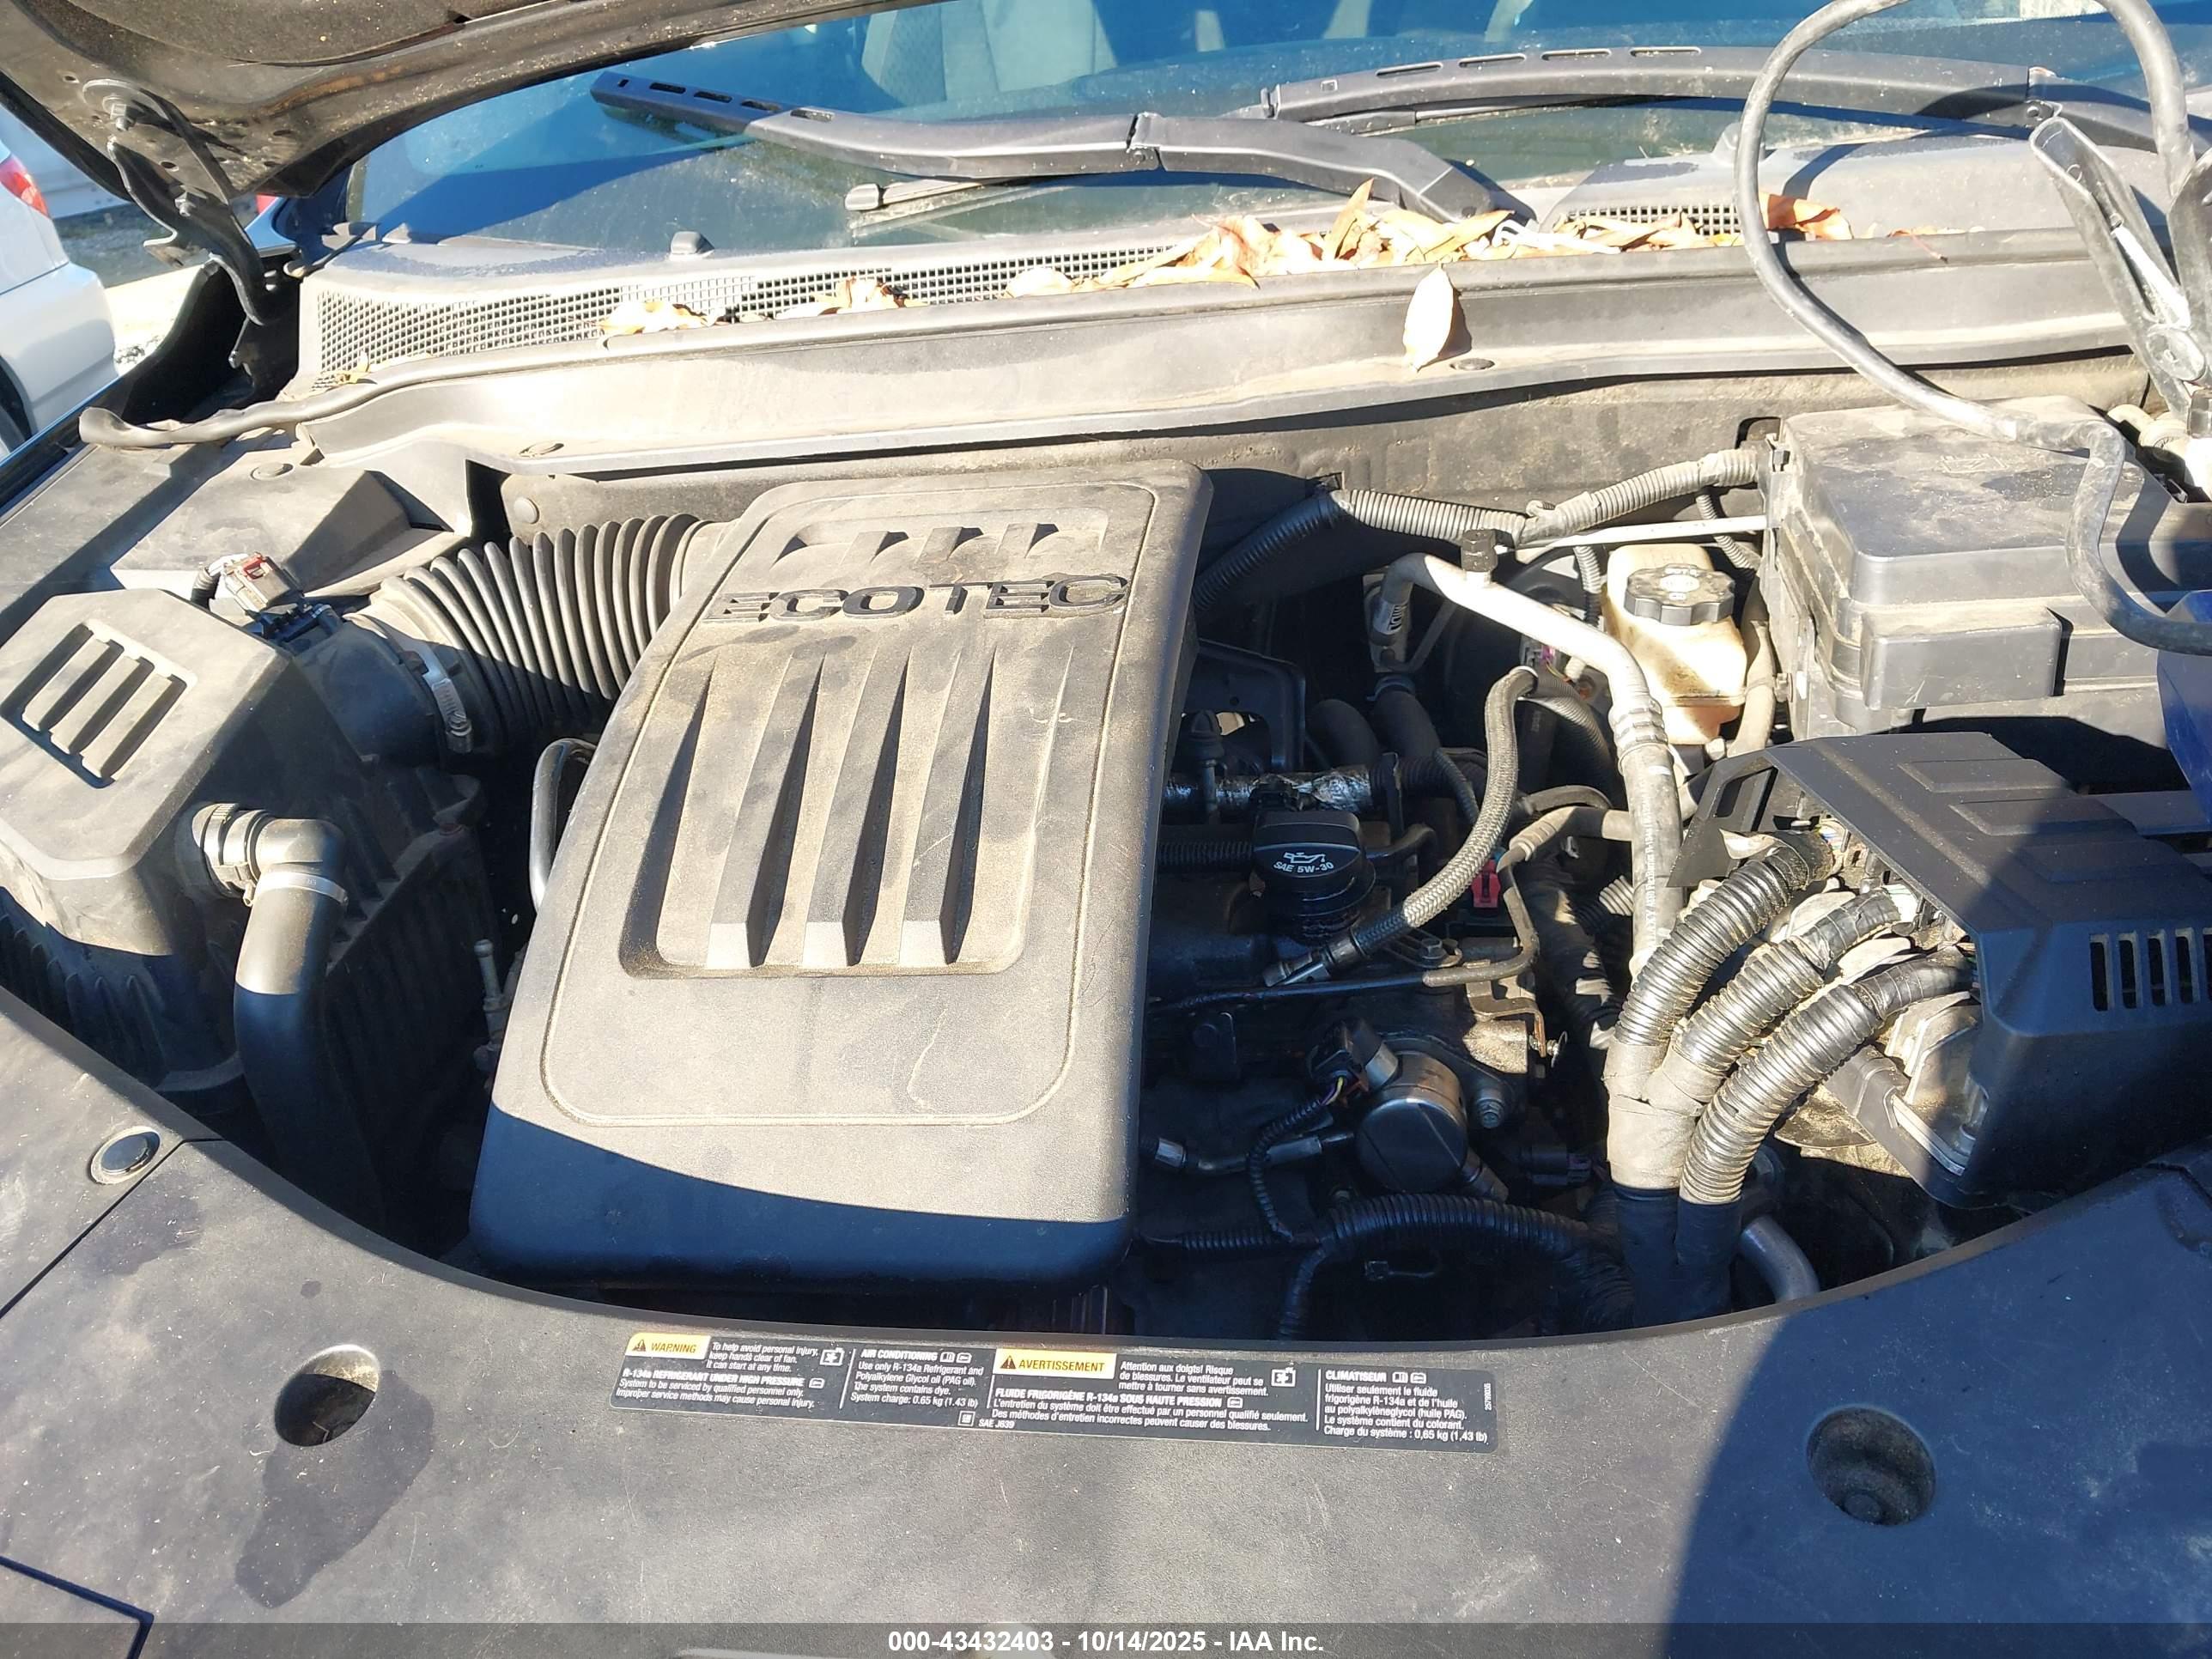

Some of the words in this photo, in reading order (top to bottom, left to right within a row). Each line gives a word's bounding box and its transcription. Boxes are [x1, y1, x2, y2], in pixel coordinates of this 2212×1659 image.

[703, 576, 1129, 623] ECOTEC
[1273, 860, 1293, 872] SAE
[1297, 861, 1334, 873] 5W-30
[650, 1342, 696, 1352] WARNING
[712, 1342, 722, 1351] To
[721, 1343, 739, 1352] help
[739, 1344, 760, 1352] avoid
[761, 1345, 794, 1355] personal
[708, 1352, 727, 1361] keep
[728, 1352, 752, 1361] hands
[753, 1353, 773, 1362] clear
[860, 1349, 877, 1358] AIR
[877, 1350, 938, 1360] CONDITIONING
[772, 1364, 793, 1372] time.
[858, 1361, 873, 1370] Use
[873, 1362, 891, 1372] only
[892, 1363, 921, 1371] R-134a
[922, 1364, 967, 1376] Refrigerant
[968, 1366, 983, 1375] and
[1018, 1358, 1104, 1372] AVERTISSEMENT
[1121, 1362, 1157, 1371] Attention
[1175, 1364, 1203, 1375] doigts!
[1205, 1365, 1233, 1376] Risque
[622, 1369, 652, 1378] R-134a
[652, 1370, 708, 1381] REFRIGERANT
[708, 1373, 738, 1382] UNDER
[738, 1375, 760, 1383] HIGH
[760, 1376, 805, 1386] PRESSURE
[854, 1371, 903, 1383] Polyalkylene
[904, 1374, 929, 1384] Glycol
[930, 1375, 940, 1383] oil
[941, 1376, 961, 1386] (PAG
[1132, 1372, 1173, 1382] blessures.
[1187, 1375, 1231, 1384] ventilateur
[1232, 1376, 1251, 1387] peut
[1325, 1370, 1386, 1382] CLIMATISEUR
[617, 1378, 647, 1389] System
[668, 1381, 702, 1390] serviced
[702, 1382, 712, 1393] by
[712, 1383, 746, 1395] qualified
[746, 1385, 785, 1396] personnel
[786, 1387, 805, 1397] only.
[853, 1382, 868, 1390] The
[869, 1382, 898, 1393] system
[899, 1383, 933, 1393] contains
[933, 1385, 951, 1395] dye.
[1118, 1381, 1146, 1390] mettre
[1154, 1382, 1184, 1392] tourner
[1208, 1385, 1267, 1396] avertissement.
[1325, 1383, 1354, 1393] Utiliser
[1356, 1384, 1401, 1395] seulement
[1403, 1387, 1411, 1395] le
[1413, 1387, 1437, 1396] fluide
[615, 1389, 650, 1400] Improper
[650, 1390, 678, 1400] service
[679, 1392, 713, 1401] methods
[713, 1395, 731, 1404] may
[756, 1395, 791, 1407] personal
[791, 1397, 816, 1408] injury.
[849, 1392, 880, 1403] System
[881, 1394, 912, 1405] charge:
[912, 1395, 932, 1404] 0.65
[932, 1396, 943, 1407] kg
[944, 1396, 966, 1407] (1.43
[967, 1398, 978, 1408] lb)
[994, 1388, 1025, 1397] FLUIDE
[1086, 1392, 1118, 1402] R-134a
[1119, 1394, 1144, 1403] SOUS
[1146, 1395, 1176, 1405] HAUTE
[1176, 1396, 1222, 1407] PRESSION
[1372, 1395, 1404, 1406] R-134a
[1407, 1397, 1416, 1406] et
[1418, 1398, 1429, 1407] de
[1036, 1401, 1048, 1409] du
[1085, 1403, 1101, 1412] doit
[1185, 1407, 1226, 1419] personnel
[1228, 1409, 1260, 1421] qualifié
[1261, 1411, 1308, 1421] seulement.
[1418, 1408, 1441, 1419] (huile
[1443, 1409, 1467, 1421] PAG).
[978, 1419, 994, 1427] SAE
[994, 1419, 1014, 1428] J639
[991, 1409, 1007, 1418] Des
[1009, 1410, 1049, 1419] méthodes
[1097, 1414, 1142, 1425] incorrectes
[1144, 1417, 1178, 1428] peuvent
[1210, 1420, 1225, 1429] des
[1227, 1421, 1270, 1431] blessures.
[1324, 1414, 1334, 1423] Le
[1375, 1417, 1410, 1427] contient
[1413, 1419, 1423, 1428] du
[1425, 1419, 1463, 1430] colorant.
[1323, 1425, 1354, 1437] Charge
[1357, 1426, 1367, 1436] du
[1436, 1431, 1448, 1442] kg
